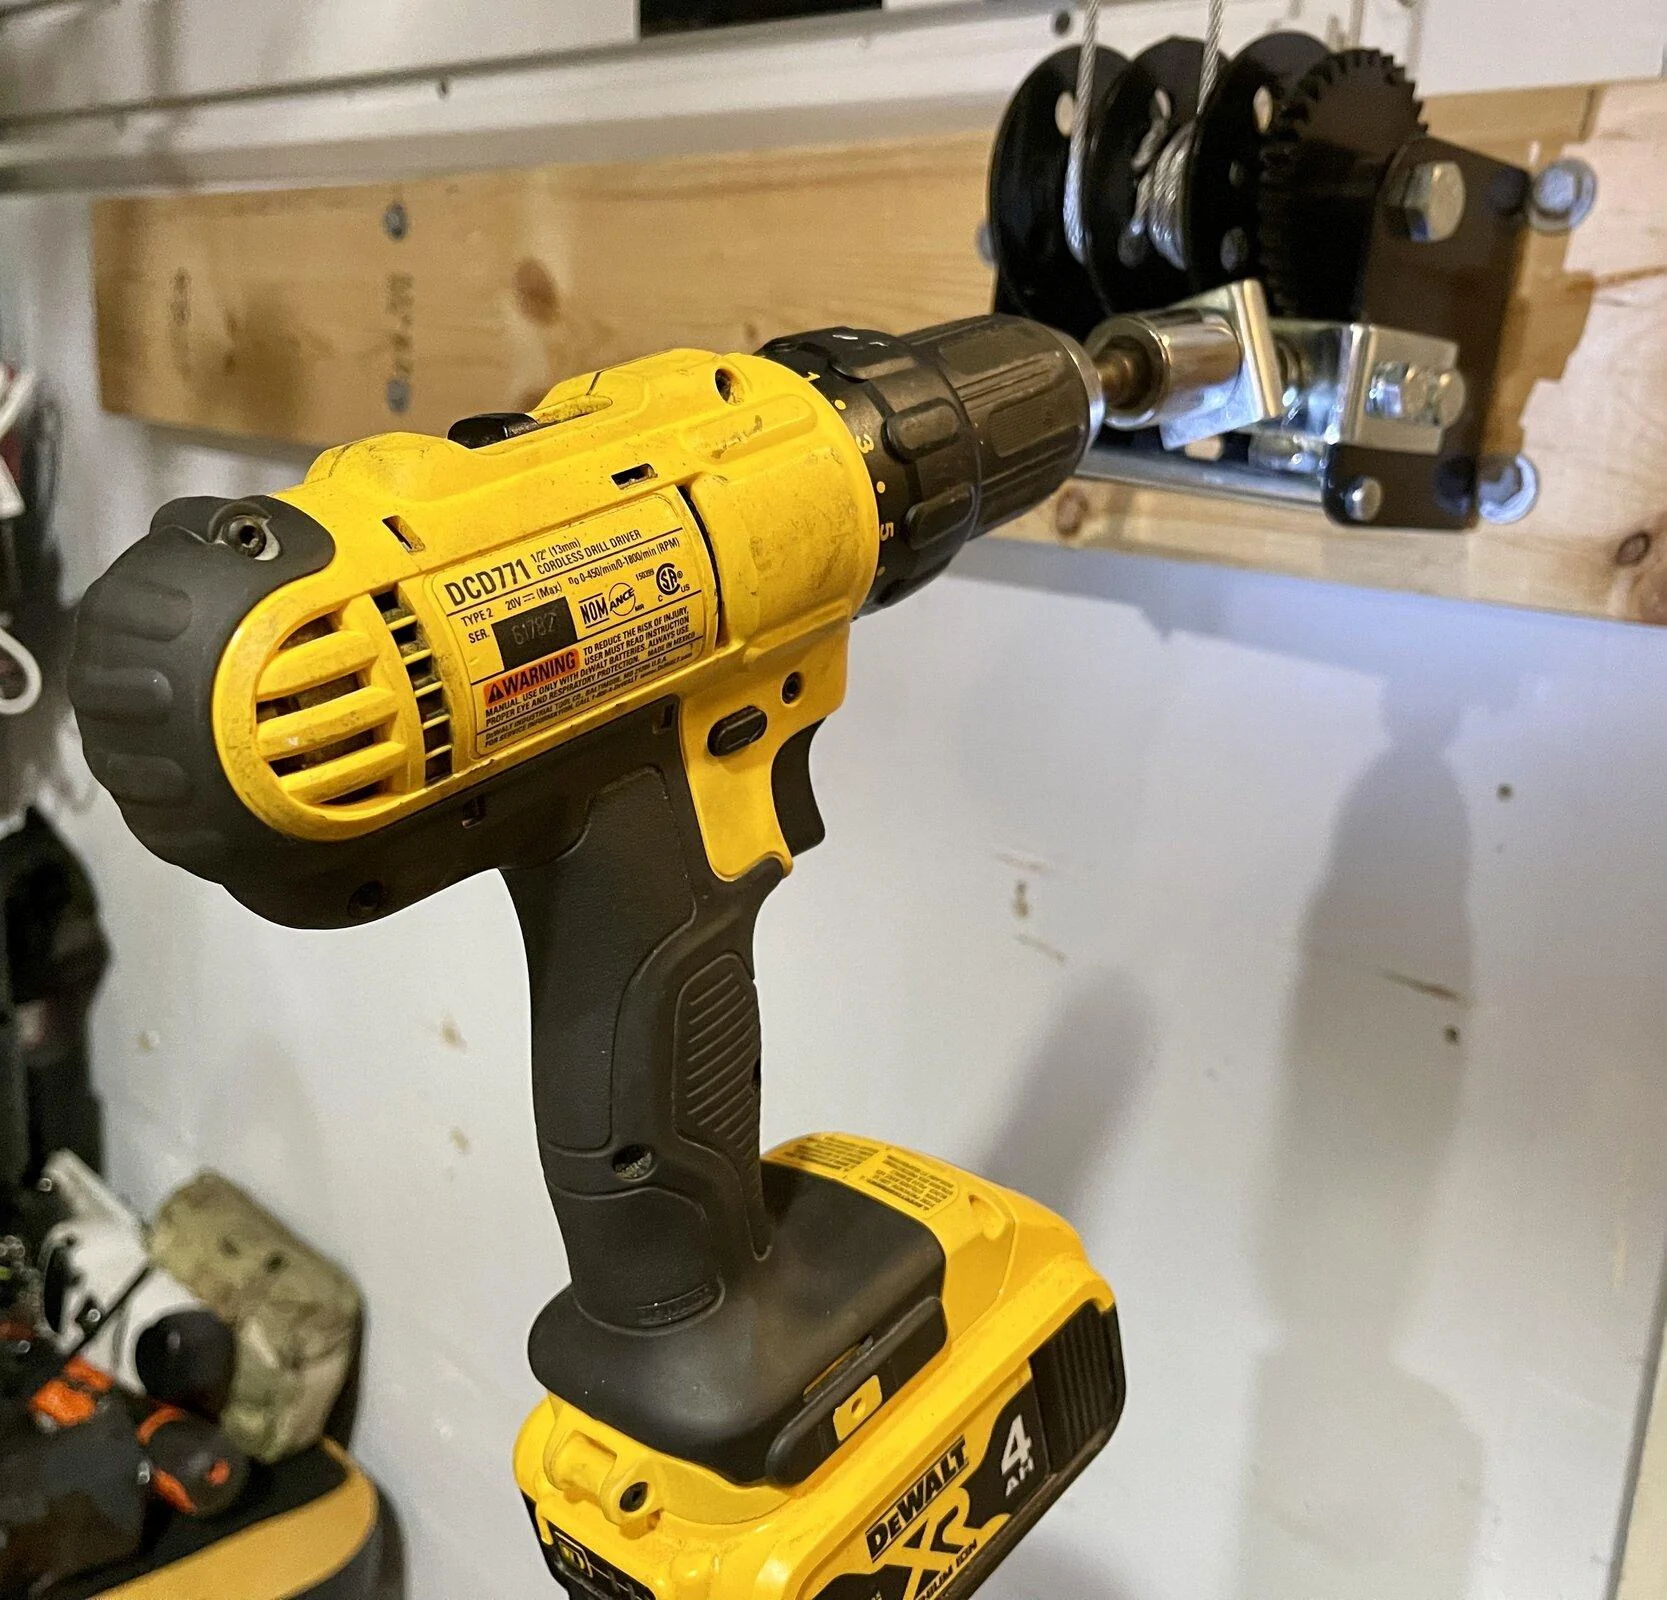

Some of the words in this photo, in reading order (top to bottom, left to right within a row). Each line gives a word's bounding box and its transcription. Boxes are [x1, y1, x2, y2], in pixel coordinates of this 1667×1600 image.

[856, 433, 875, 454] 3
[537, 550, 584, 574] CORDLESS
[584, 541, 610, 558] DRILL
[609, 529, 642, 548] DRIVER
[548, 537, 581, 557] (13mm)
[880, 521, 894, 542] 5
[444, 558, 531, 606] DCD771
[460, 610, 487, 627] TYPE
[486, 608, 494, 618] 2
[505, 597, 522, 611] 20V
[536, 581, 563, 600] (Max)
[656, 537, 680, 555] (RPM)
[609, 587, 635, 612] ANCE
[580, 596, 609, 625] NOM
[502, 651, 576, 696] WARNING
[583, 646, 593, 656] TO
[594, 633, 621, 650] REDUCE
[622, 628, 636, 639] THE
[637, 620, 654, 633] RISK
[654, 616, 663, 627] OF
[523, 688, 537, 701] USE
[539, 680, 557, 695] ONLY
[559, 671, 579, 686] WITH
[648, 631, 675, 648] ALWAYS
[676, 624, 689, 636] USE
[584, 653, 606, 666] USER
[604, 642, 625, 657] MUST
[626, 634, 644, 649] READ
[645, 616, 689, 641] INSTRUCTION
[647, 645, 666, 657] MADE
[485, 708, 515, 727] PROPER
[516, 701, 530, 714] EYE
[531, 694, 548, 706] AND
[548, 674, 596, 699] RESPIRATORY
[1001, 1413, 1032, 1478] 4
[955, 1538, 978, 1568] ION
